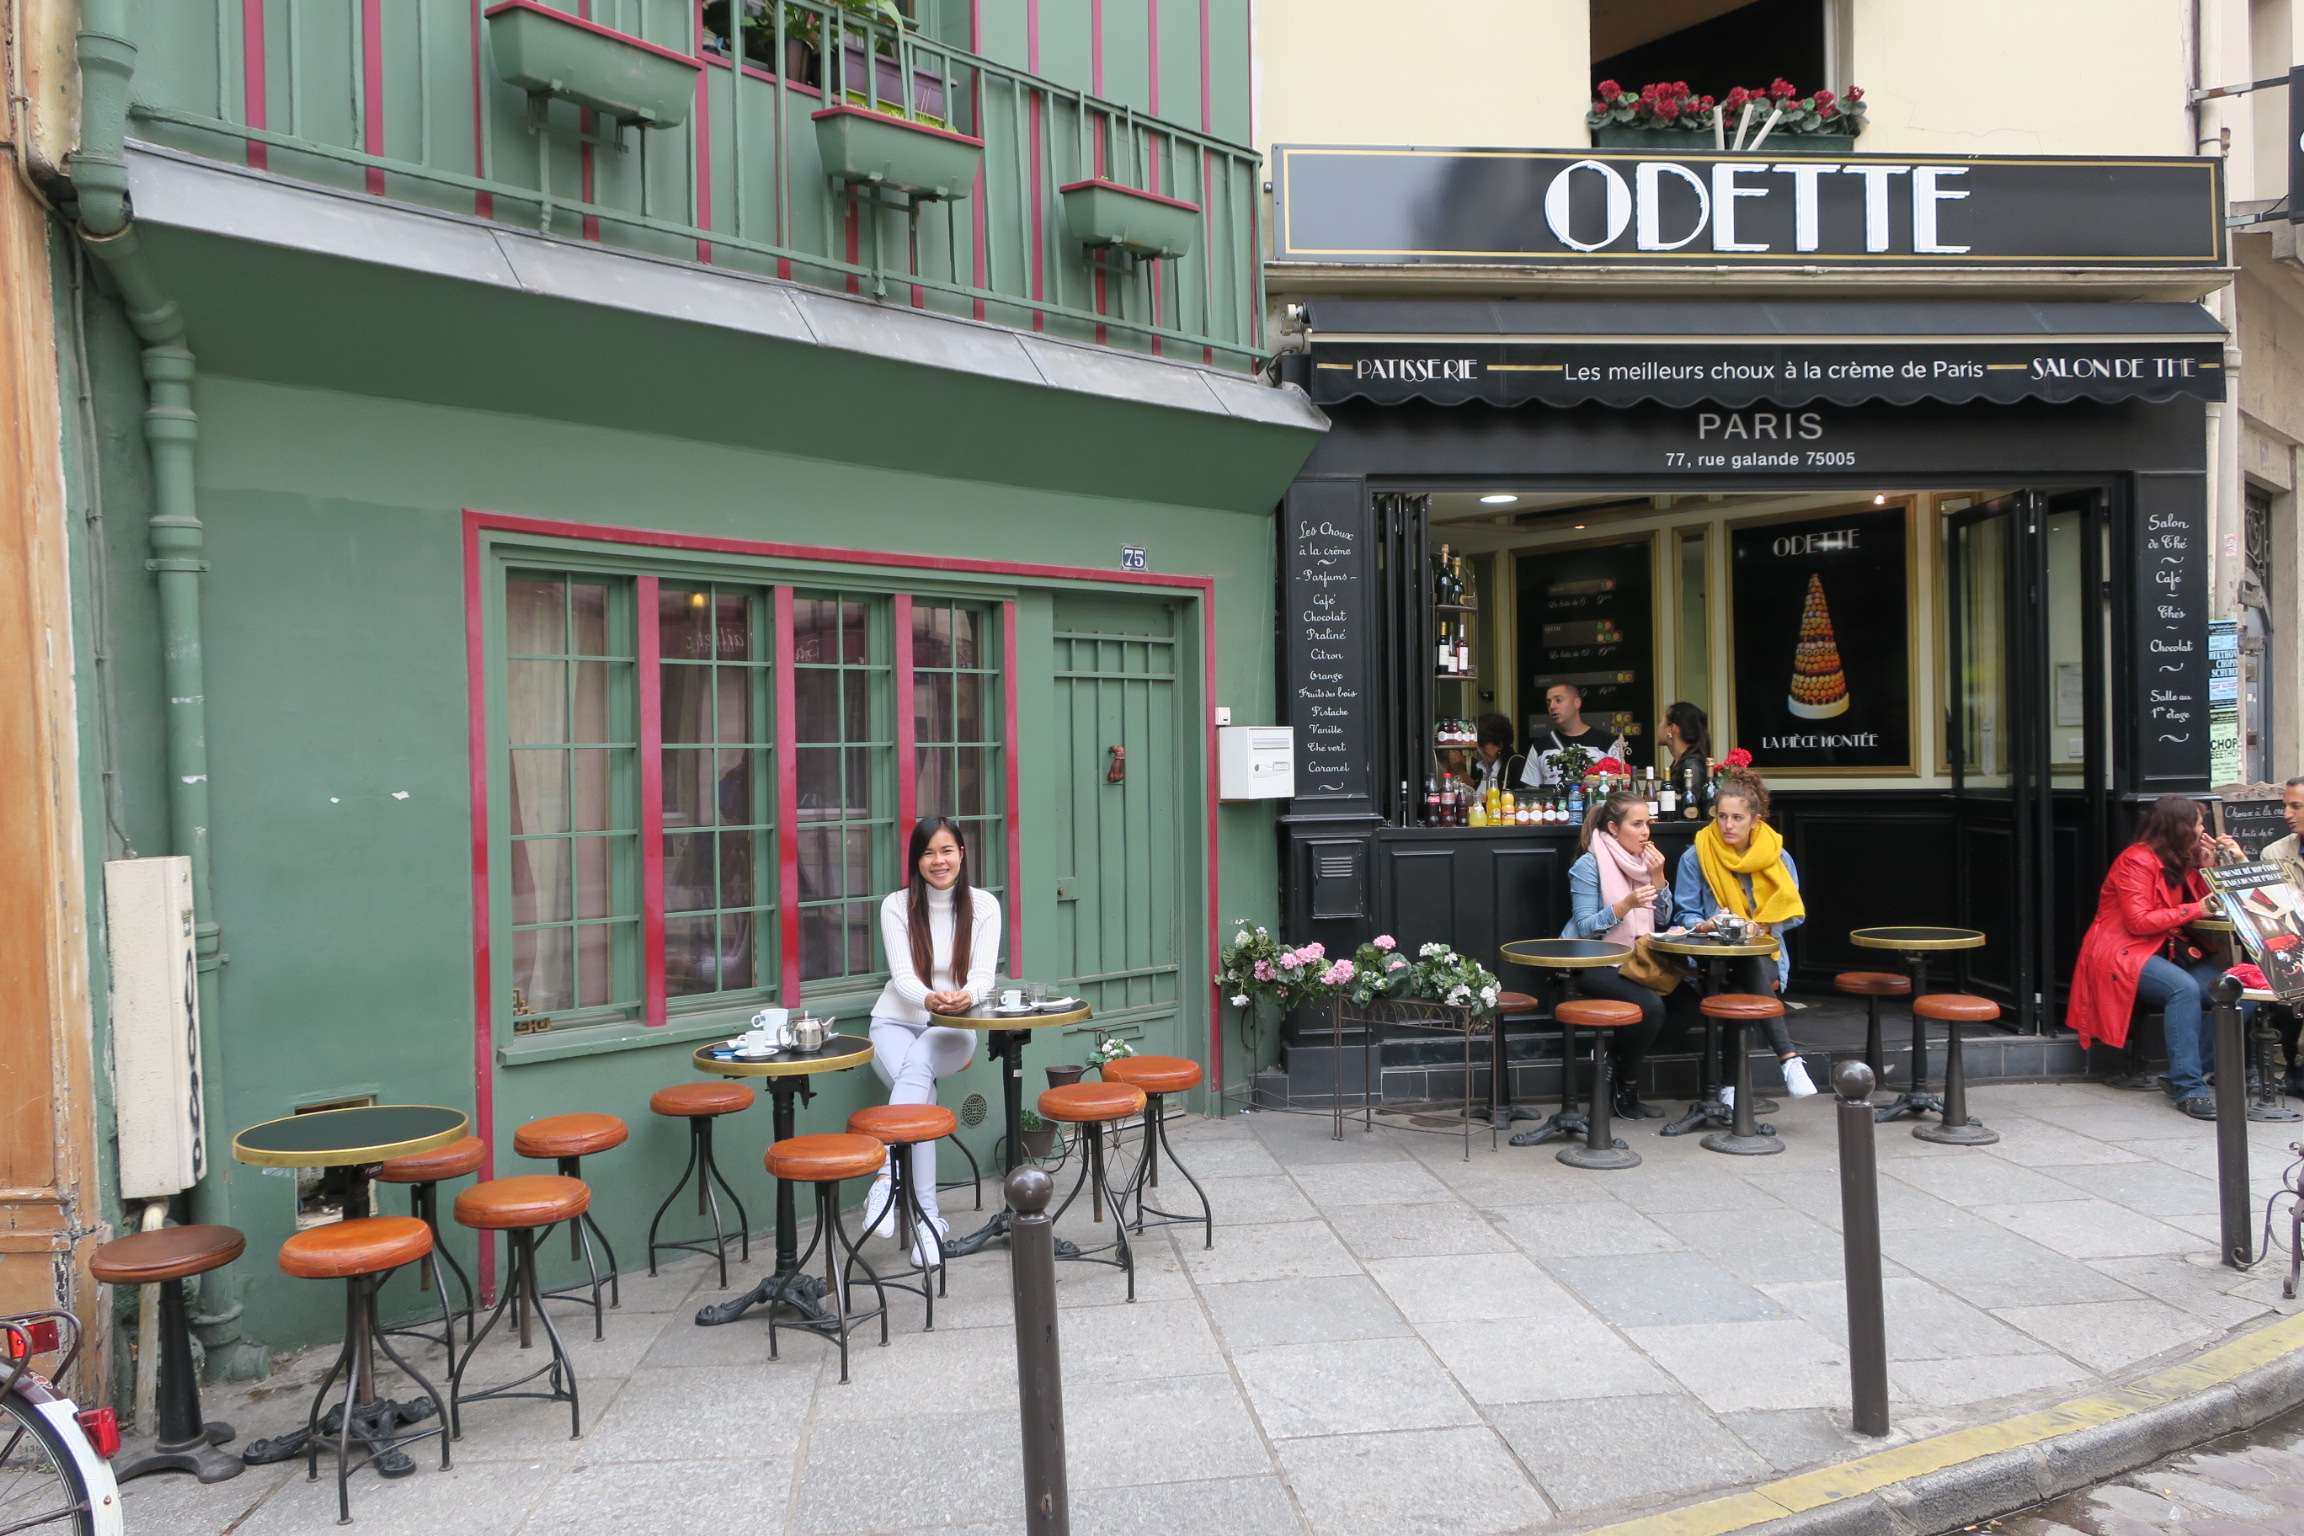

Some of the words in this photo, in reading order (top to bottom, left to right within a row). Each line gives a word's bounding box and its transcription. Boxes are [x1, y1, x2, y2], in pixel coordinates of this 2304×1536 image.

[1544, 159, 1971, 252] ODETTE
[1356, 358, 1478, 383] PATISSERIE
[1565, 362, 1601, 381] Les
[1608, 361, 1703, 381] meilleurs
[1711, 361, 1775, 380] choux
[1784, 361, 1797, 379] à
[1804, 361, 1821, 379] la
[1828, 361, 1894, 379] crème
[1902, 361, 1926, 379] de
[1933, 360, 1983, 379] Paris
[2031, 357, 2110, 380] SALON
[2115, 358, 2144, 379] DE
[2152, 358, 2196, 378] THE
[1698, 412, 1824, 440] PARIS
[1665, 453, 1692, 469] 77,
[1698, 454, 1725, 466] rue
[1731, 452, 1799, 469] galande
[1806, 452, 1856, 466] 75005
[2148, 512, 2190, 531] Salon
[1299, 520, 1317, 539] Les
[1320, 521, 1354, 541] Choux
[1299, 545, 1307, 556] à
[1309, 541, 1321, 556] la
[1323, 545, 1351, 556] crème
[1773, 528, 1860, 557] ODETTE
[2147, 538, 2160, 549] de
[2160, 534, 2188, 549] Thé
[1124, 549, 1144, 567] 75
[1303, 569, 1347, 588] Parfums
[2155, 569, 2182, 591] Café
[1313, 593, 1336, 611] Café
[1303, 610, 1347, 622] Chocolat
[2157, 604, 2186, 619] Thés
[1306, 627, 1346, 641] Praliné
[2149, 639, 2194, 652] Chocolat
[1310, 648, 1343, 660] Citron
[1310, 669, 1343, 683] Orange
[1298, 686, 1325, 699] Fruits
[1337, 686, 1358, 698] bois
[2150, 689, 2177, 702] Salle
[1311, 705, 1349, 717] Pistache
[1308, 723, 1344, 734] Vanille
[1307, 741, 1327, 752] Thé
[1327, 741, 1347, 752] vert
[1762, 736, 1779, 749] LA
[1782, 733, 1818, 748] PIÈCE
[1820, 731, 1878, 748] MONTÉE
[1308, 760, 1350, 773] Caramel
